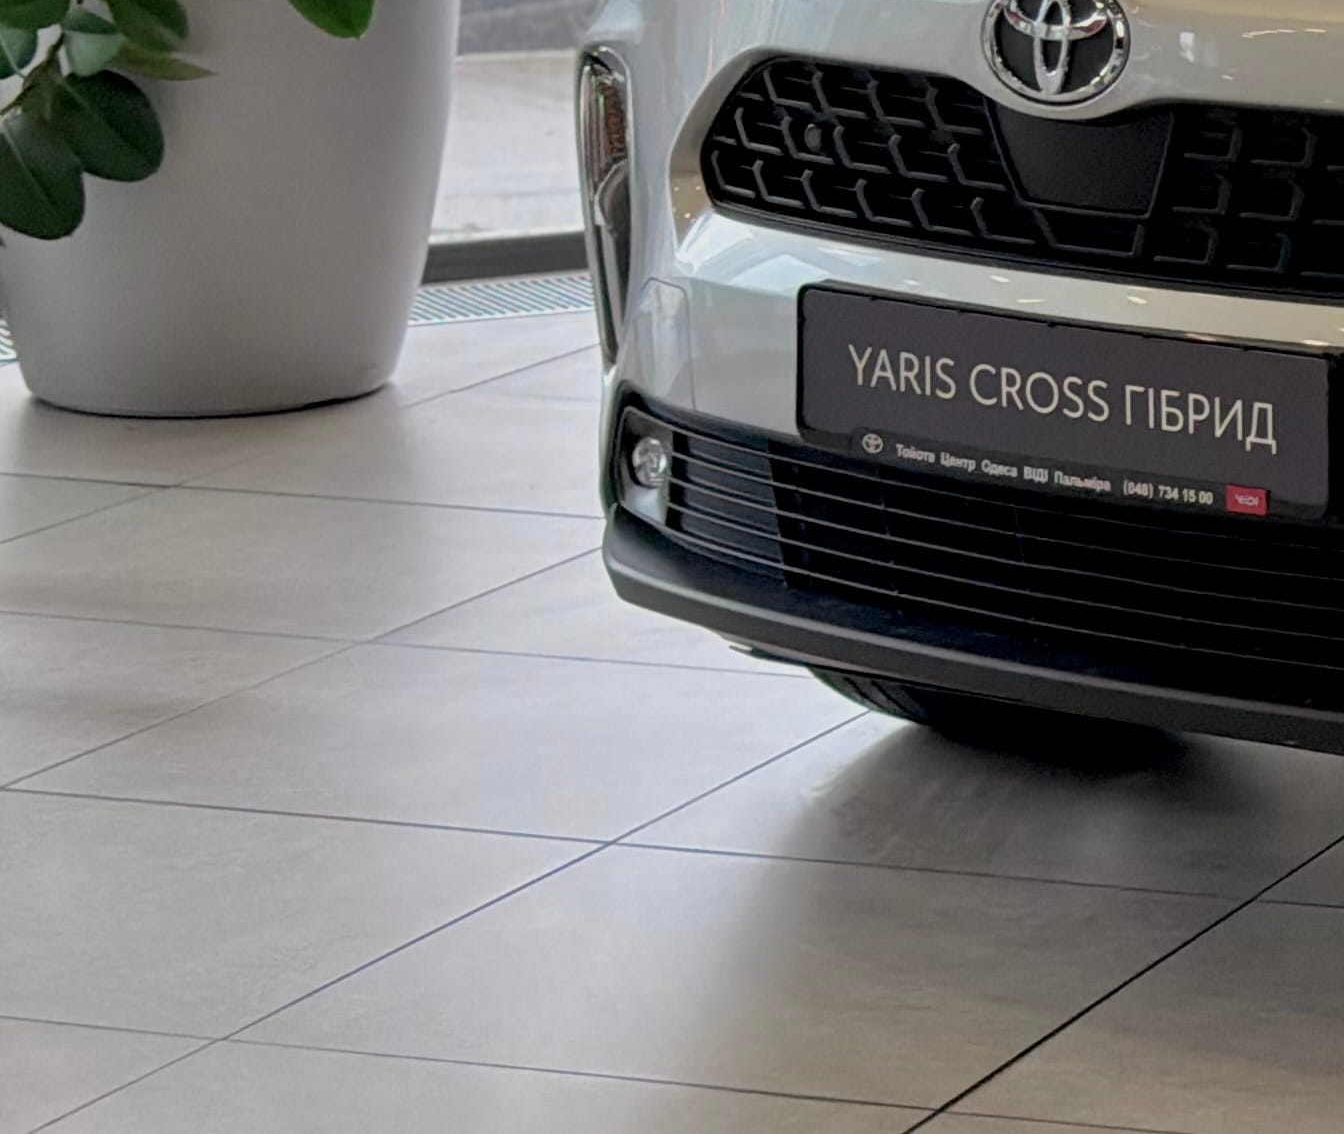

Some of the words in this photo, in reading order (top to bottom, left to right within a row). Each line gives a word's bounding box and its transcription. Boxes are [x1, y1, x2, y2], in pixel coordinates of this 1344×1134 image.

[848, 343, 956, 400] YARIS
[969, 363, 1110, 423] CROSS
[1124, 384, 1278, 455] ГІБРИД
[1158, 484, 1179, 501] 734
[1182, 488, 1196, 504] 15
